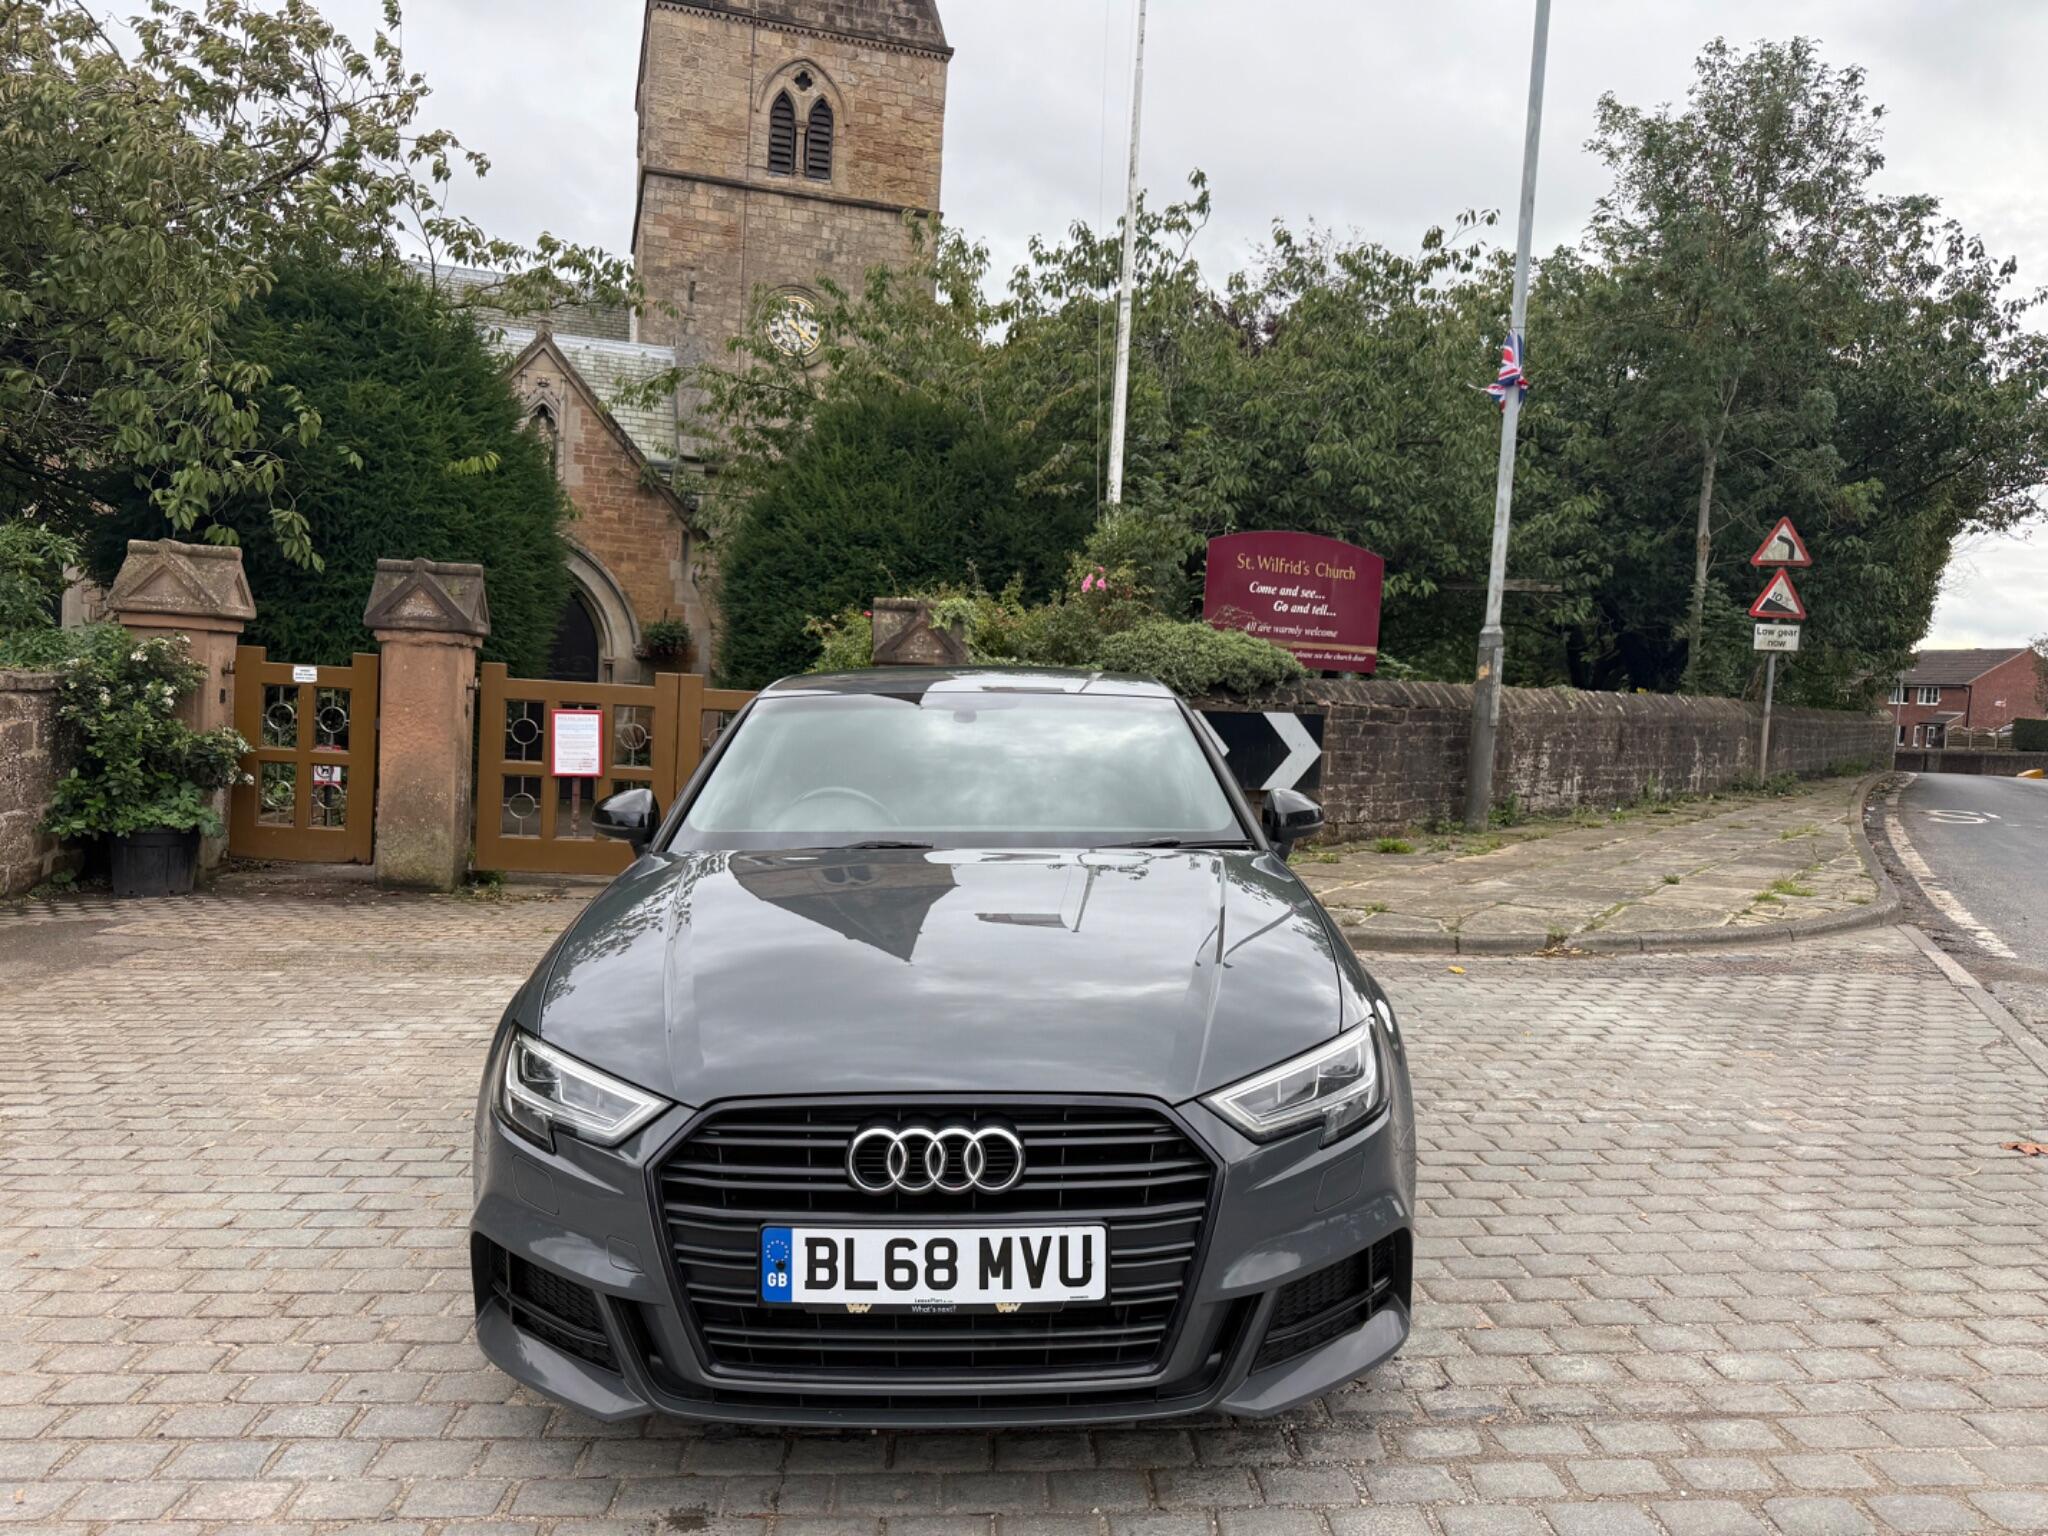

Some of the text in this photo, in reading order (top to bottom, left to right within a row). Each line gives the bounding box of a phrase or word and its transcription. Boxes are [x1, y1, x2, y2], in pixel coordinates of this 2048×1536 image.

[1237, 552, 1356, 580] St. Wilfrid's Church
[1249, 581, 1326, 600] Come and see...
[1273, 600, 1336, 617] Go and tell...
[1258, 625, 1271, 633] are
[1273, 625, 1302, 637] warmly
[1305, 626, 1338, 638] welcome
[1757, 626, 1797, 638] Low gear
[1768, 640, 1786, 648] now
[1324, 652, 1333, 660] the
[1334, 653, 1352, 661] church
[804, 1234, 1093, 1291] BL68 MVU
[767, 1272, 788, 1288] GB
[911, 1304, 958, 1313] What's next?
